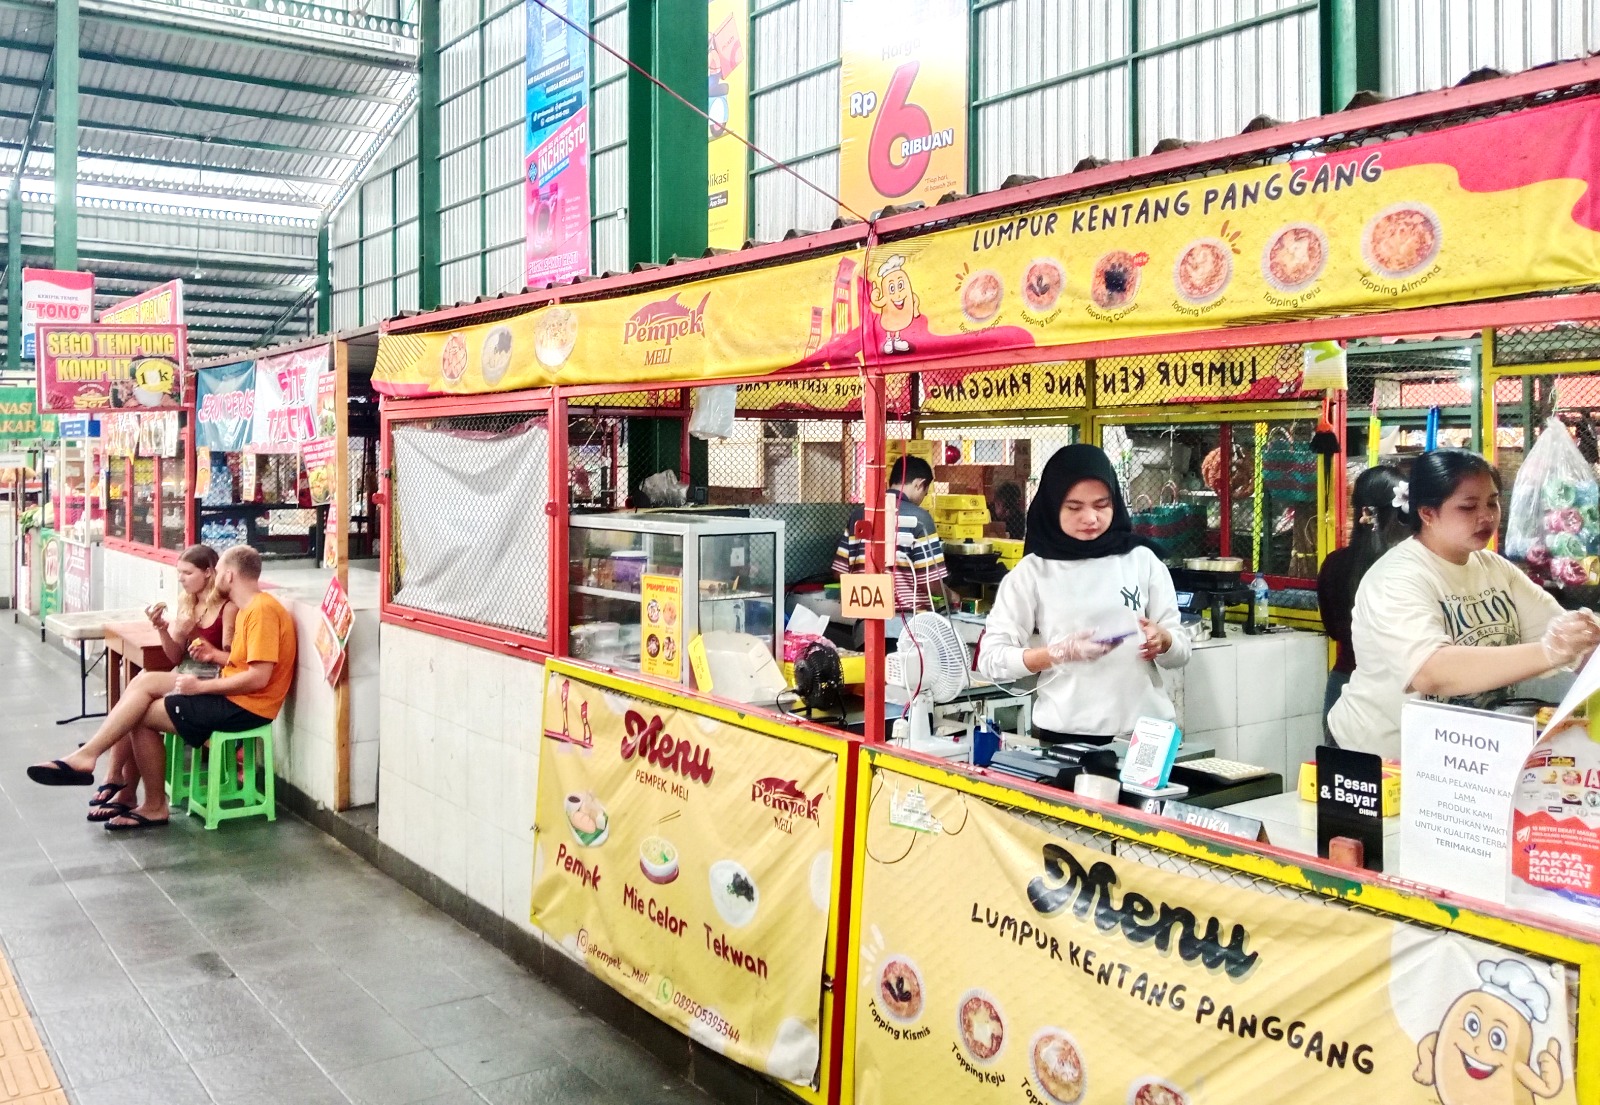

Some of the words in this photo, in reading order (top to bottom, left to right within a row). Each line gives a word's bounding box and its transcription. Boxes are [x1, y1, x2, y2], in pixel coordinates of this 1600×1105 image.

[850, 91, 877, 118] Rp
[868, 60, 933, 198] 6
[901, 128, 954, 158] RIBUAN
[708, 169, 729, 187] likasi
[973, 212, 1059, 252] LUMPUR
[1072, 190, 1191, 234] KENTANG
[1204, 152, 1383, 215] PANGGANG
[1133, 256, 1148, 265] NEW
[1358, 275, 1398, 296] Topping
[1400, 264, 1442, 294] Almond
[1171, 300, 1199, 317] Topping
[1200, 296, 1227, 315] Kenari
[1263, 291, 1298, 308] Topping
[1300, 286, 1321, 303] Keju
[1019, 310, 1045, 328] Topping
[1085, 304, 1114, 323] Topping
[624, 311, 705, 345] Pempek
[47, 332, 93, 357] SEGO
[94, 332, 176, 357] TEMPONG
[56, 358, 132, 382] KOMPLIT
[644, 348, 672, 367] MELI
[849, 586, 884, 609] ADA
[620, 709, 715, 785] Menu
[1435, 728, 1499, 753] MOHON
[1444, 755, 1490, 775] MAAF
[635, 770, 667, 793] PEMPEK
[670, 784, 690, 801] MELI
[1334, 774, 1378, 794] Pesan
[1416, 770, 1448, 785] APABILA
[1448, 777, 1496, 795] PELAYANAN
[751, 781, 820, 828] Pempek
[1320, 785, 1332, 799] &
[1334, 788, 1378, 808] Bayar
[1454, 792, 1477, 804] LAMA
[1359, 808, 1378, 818] DISINI
[1419, 808, 1481, 830] MEMBUTUHKAN
[1482, 823, 1508, 836] WAKT
[1437, 800, 1471, 815] PRODUK
[1472, 808, 1493, 820] KAMI
[773, 815, 793, 835] MELI
[1415, 820, 1442, 833] UNTUK
[1443, 827, 1481, 843] KUALITAS
[1481, 836, 1507, 849] TERBA
[1435, 837, 1492, 859] TERIMAKASIH
[1529, 850, 1582, 862] PASAR
[555, 843, 602, 892] Pempk
[1529, 858, 1594, 873] RAKYAT
[1529, 866, 1591, 880] KLOJEN
[1529, 873, 1592, 889] NIKMAT
[623, 883, 645, 916] Mie
[647, 902, 689, 938] Celor
[1027, 841, 1262, 982] Menu
[703, 922, 769, 980] Tekwan
[971, 903, 1063, 960] LUMPUR
[1069, 940, 1186, 1012] KENTANG
[1196, 994, 1375, 1075] PANGGANG
[673, 991, 741, 1044] 089505395544
[868, 998, 901, 1041] Topping
[902, 1026, 931, 1041] Kismis
[951, 1042, 984, 1083] Topping
[984, 1072, 1006, 1087] Keju
[1020, 1077, 1048, 1105] Topp
